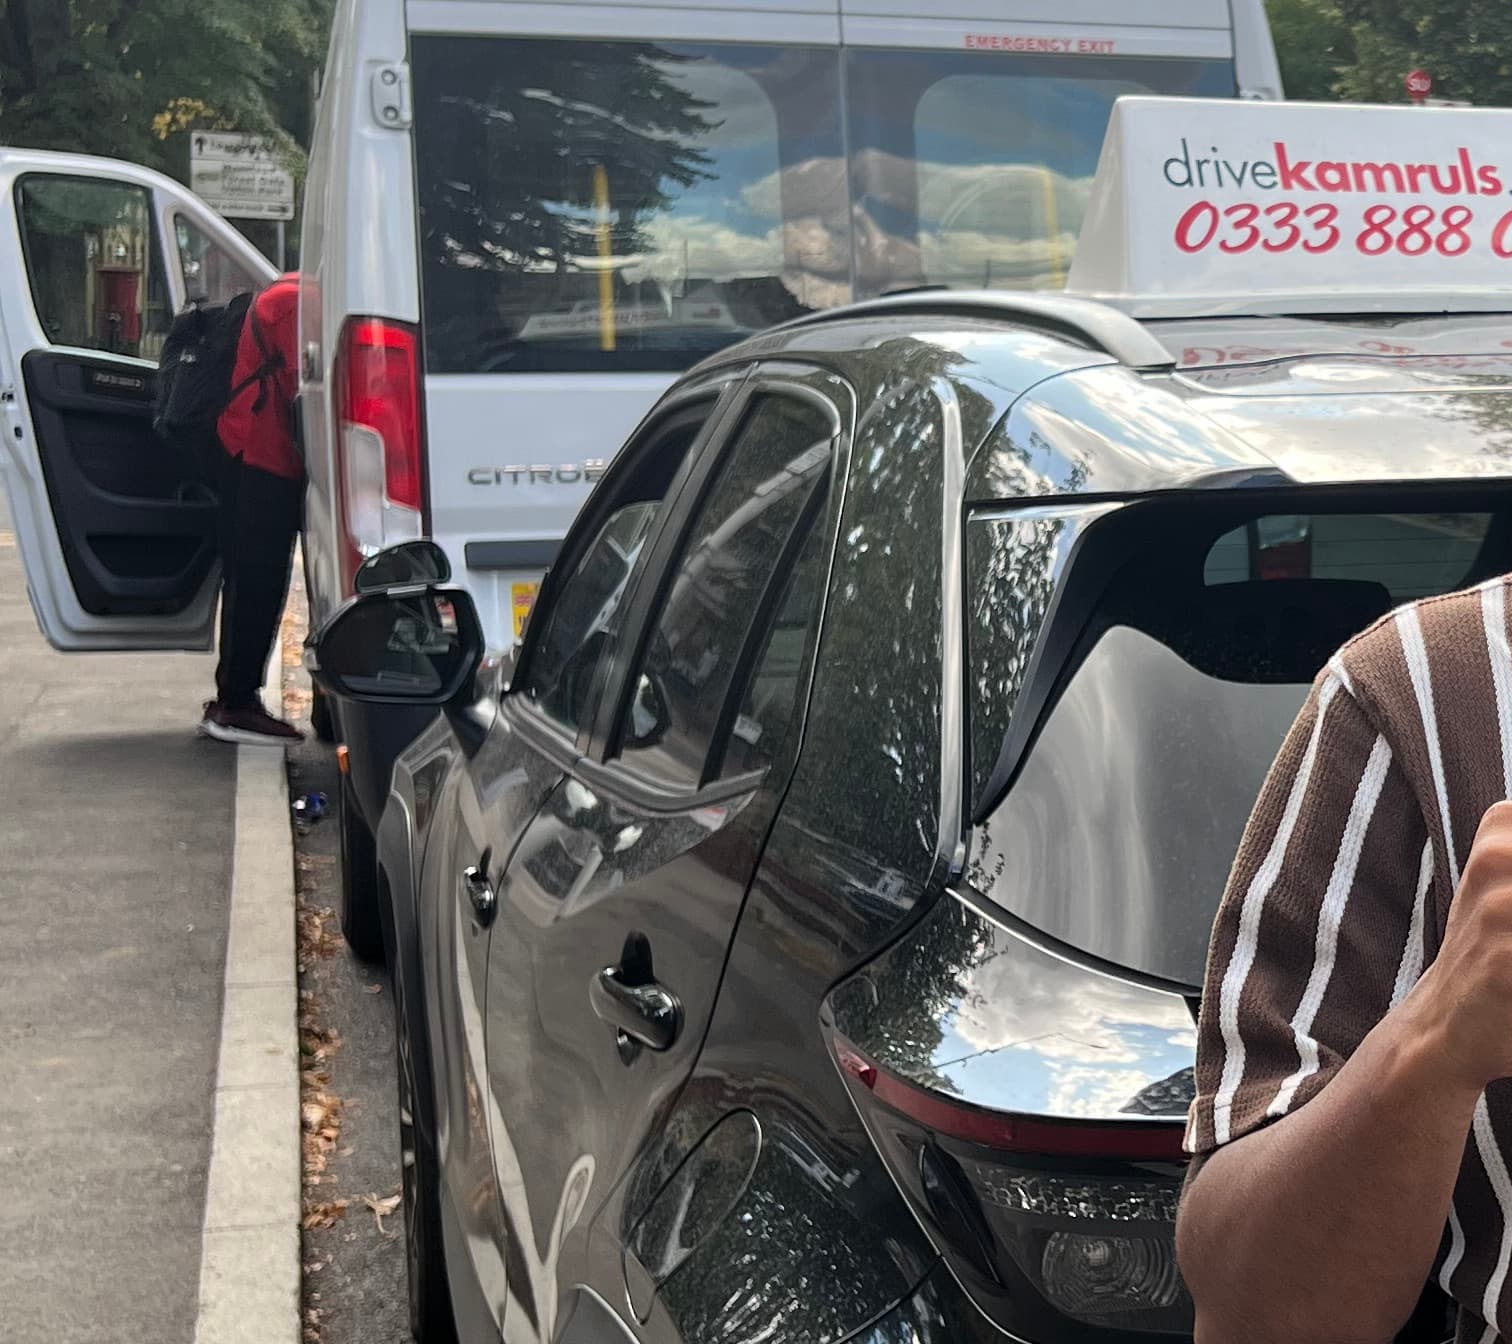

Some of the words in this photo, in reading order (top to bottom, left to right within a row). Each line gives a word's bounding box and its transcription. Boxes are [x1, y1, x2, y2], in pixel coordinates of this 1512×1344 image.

[964, 35, 1070, 52] EMERGENCY
[1078, 40, 1115, 53] EXIT
[1174, 200, 1341, 255] 0333
[1355, 205, 1472, 257] 888
